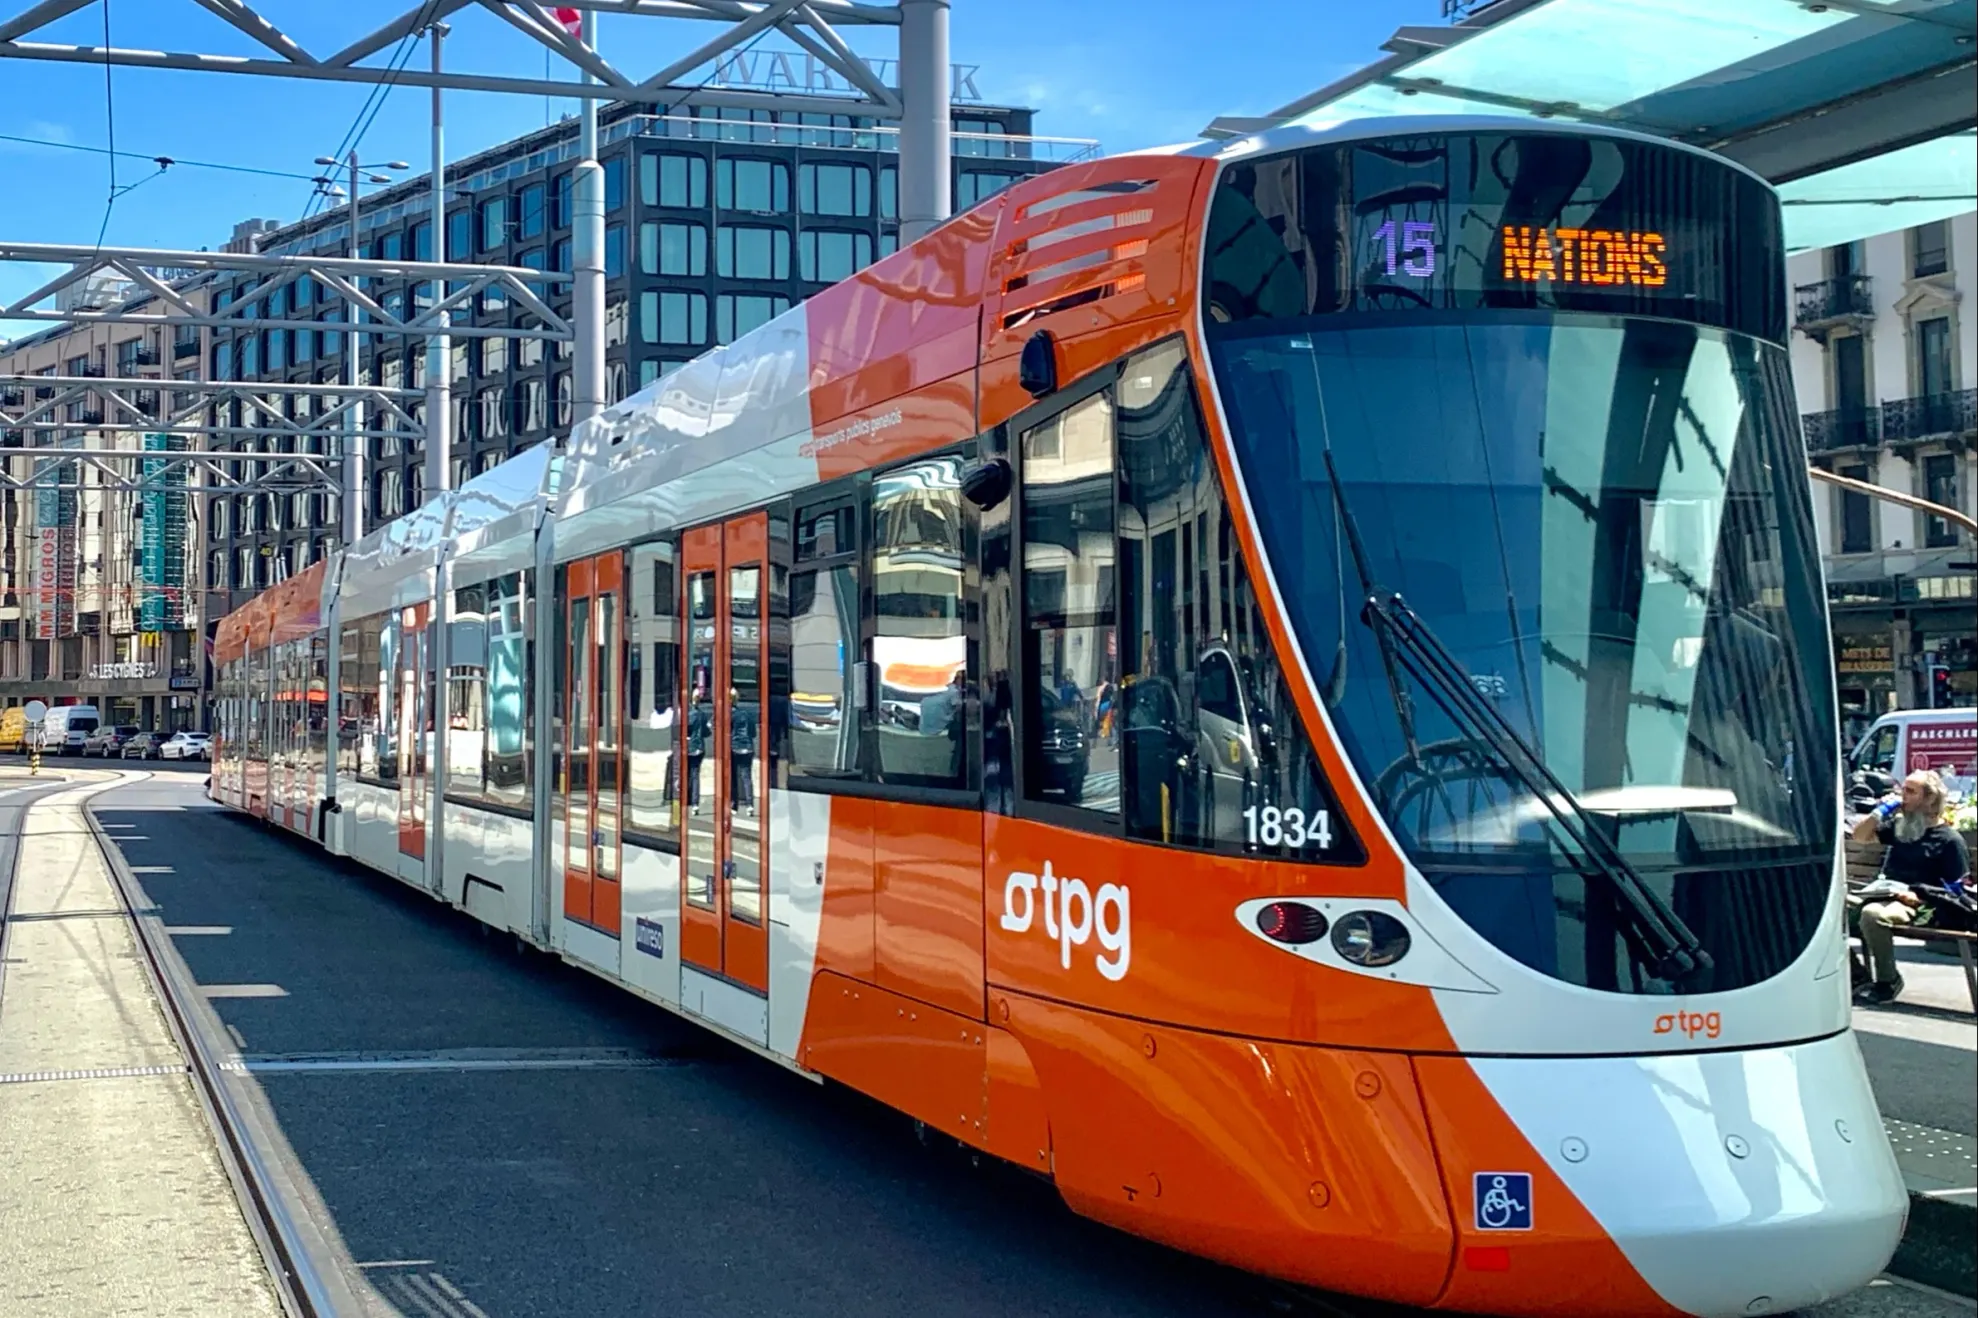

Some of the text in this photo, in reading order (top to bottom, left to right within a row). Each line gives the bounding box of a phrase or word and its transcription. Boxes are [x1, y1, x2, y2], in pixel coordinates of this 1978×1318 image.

[714, 49, 982, 100] WARK
[1372, 220, 1435, 277] 15
[1503, 225, 1667, 286] NATIONS
[39, 528, 55, 604] MIGROS
[1242, 805, 1332, 849] 1834
